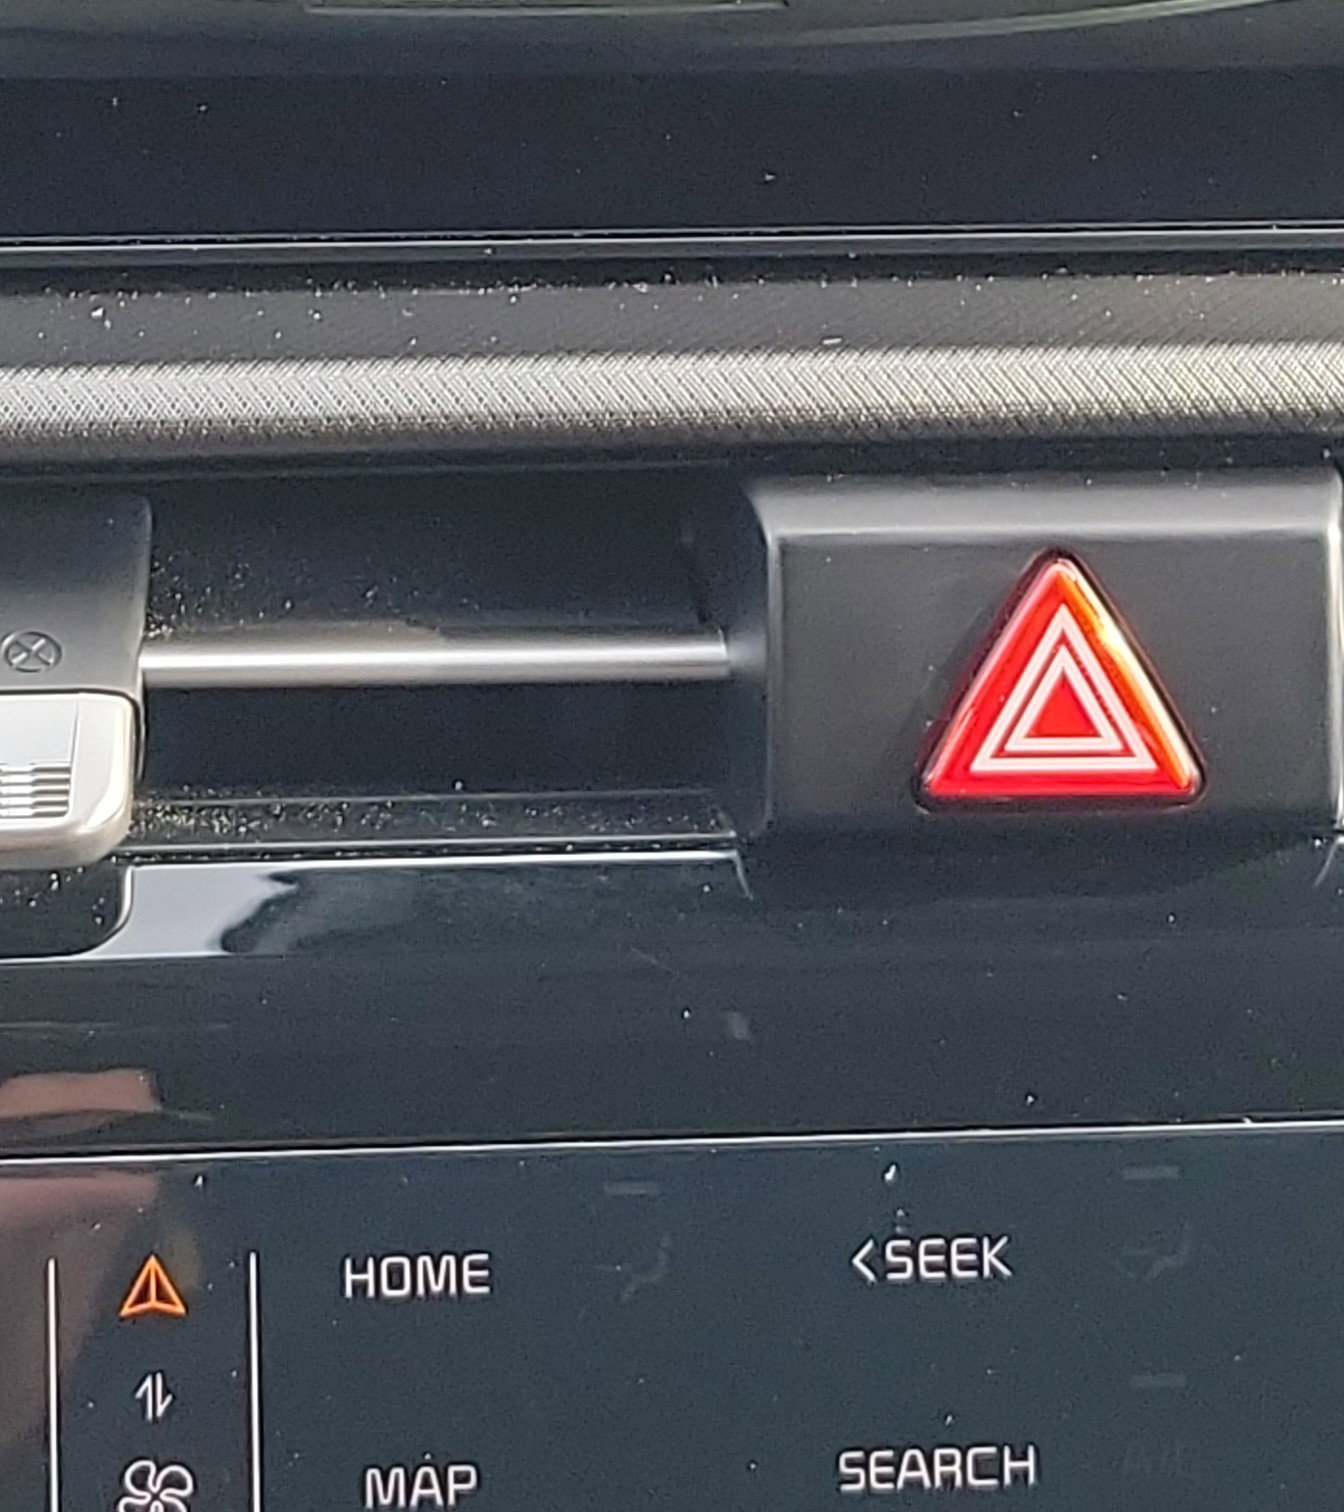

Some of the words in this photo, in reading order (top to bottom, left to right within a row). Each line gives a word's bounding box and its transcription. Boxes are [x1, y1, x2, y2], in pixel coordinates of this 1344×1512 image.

[343, 1253, 490, 1298] HOME
[364, 1463, 478, 1509] MAP
[838, 1444, 1036, 1492] SEARCH
